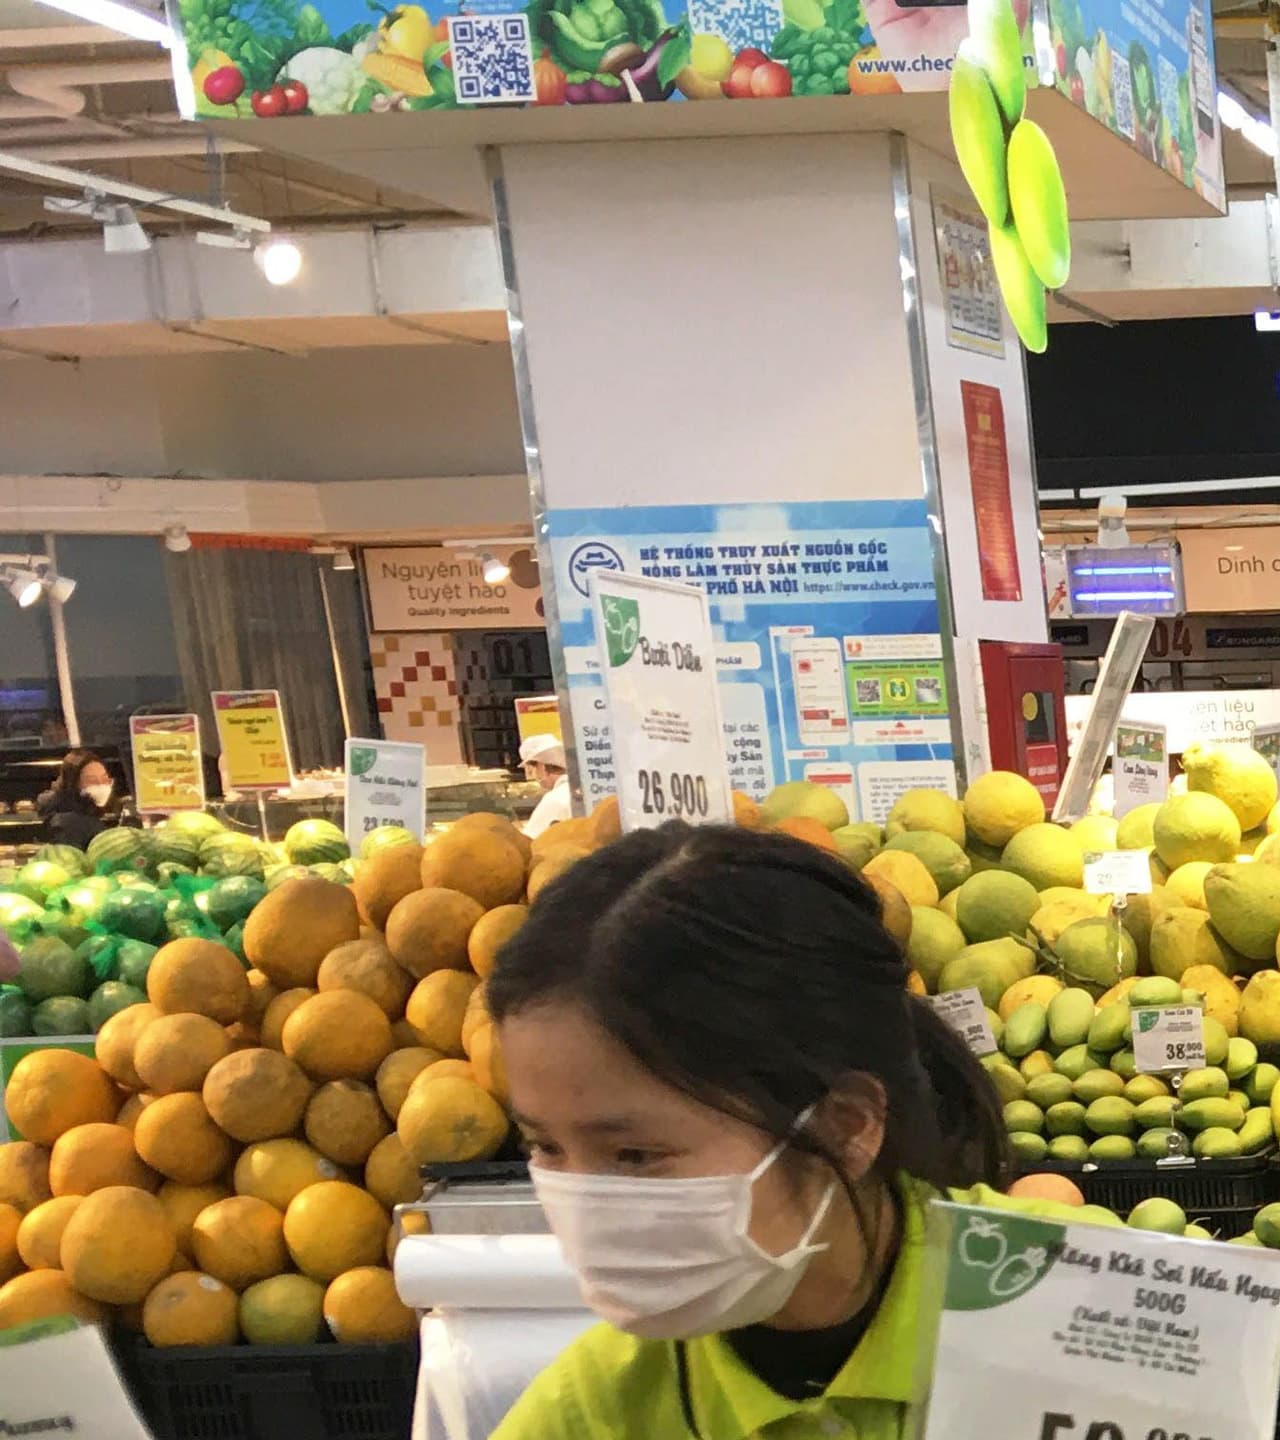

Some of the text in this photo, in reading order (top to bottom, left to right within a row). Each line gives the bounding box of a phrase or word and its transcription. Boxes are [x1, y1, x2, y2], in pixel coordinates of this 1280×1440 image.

[857, 53, 1035, 74] www.checn
[718, 546, 757, 560] TRUY
[761, 541, 800, 558] XUẤT
[858, 540, 887, 556] GỐC
[382, 560, 461, 582] Nguyên
[1218, 555, 1264, 574] Dinh
[638, 768, 709, 817] 26.900
[1133, 1287, 1187, 1316] 500G
